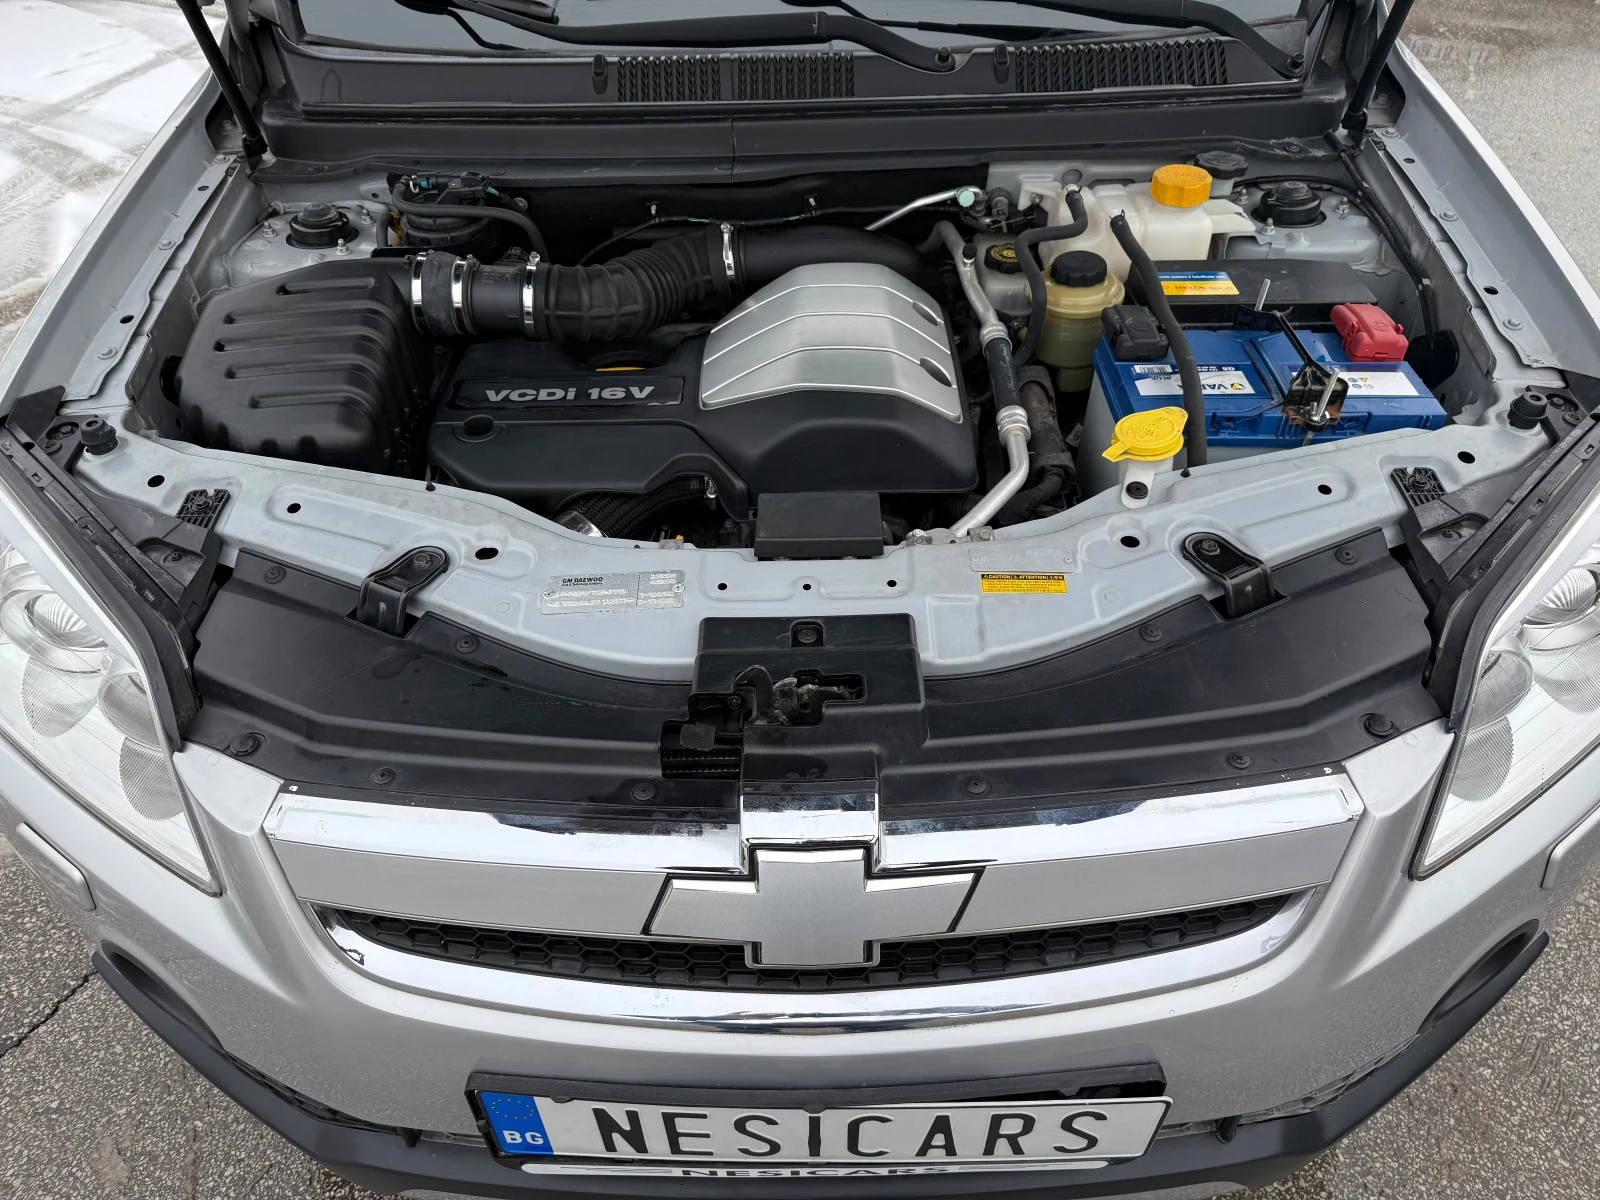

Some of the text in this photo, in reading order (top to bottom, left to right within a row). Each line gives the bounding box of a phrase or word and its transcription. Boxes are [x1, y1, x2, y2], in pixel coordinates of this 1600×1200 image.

[485, 386, 655, 402] VCDi 16V
[502, 1130, 544, 1145] BG
[592, 1107, 1108, 1157] NESICARS
[682, 1167, 949, 1177] NESICARS
